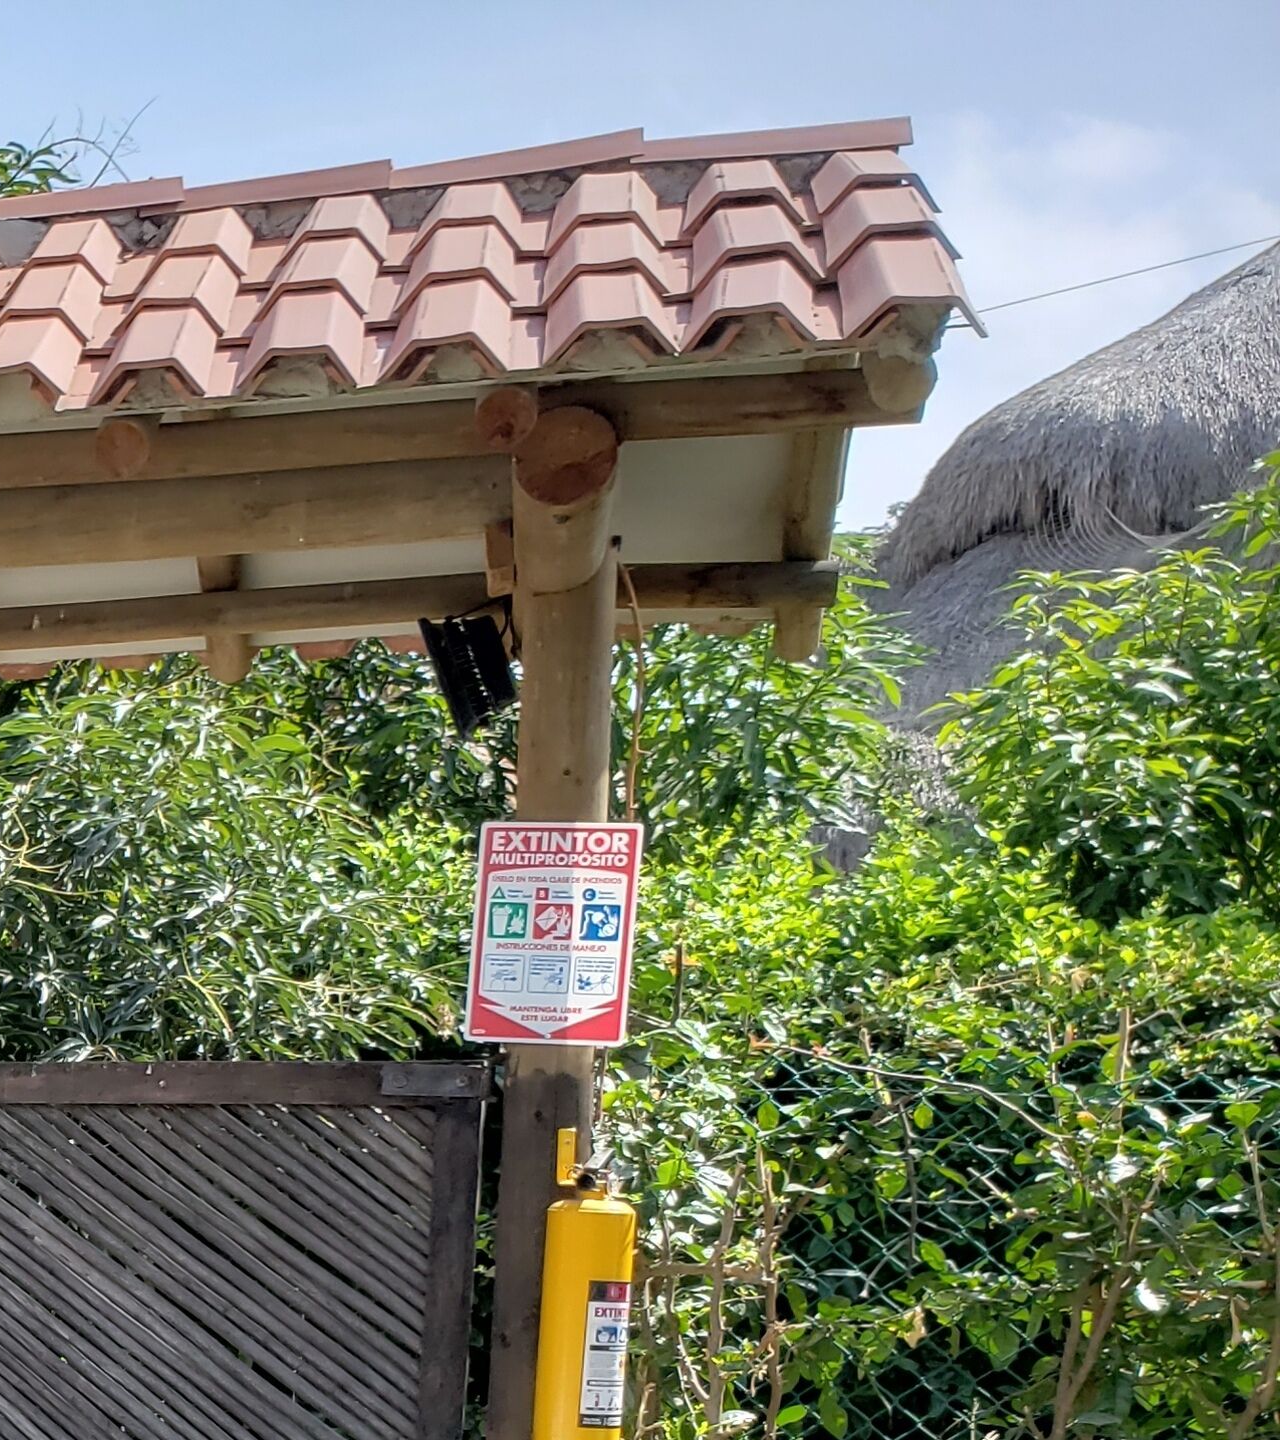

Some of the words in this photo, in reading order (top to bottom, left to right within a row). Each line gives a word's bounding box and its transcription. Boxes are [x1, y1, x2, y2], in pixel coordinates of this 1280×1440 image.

[491, 831, 630, 854] EXTINTOR
[489, 850, 629, 867] MULTIPROPÓSITO
[549, 876, 570, 884] CLASE
[583, 877, 622, 885] INCENDIOS
[495, 942, 558, 951] INSTRUCCIONES
[560, 943, 571, 952] DE
[572, 944, 607, 953] MANEJO
[509, 1005, 558, 1013] MANTENGA
[560, 1006, 582, 1014] LIBRE
[520, 1014, 539, 1022] ESTE
[541, 1015, 569, 1023] LUGAR
